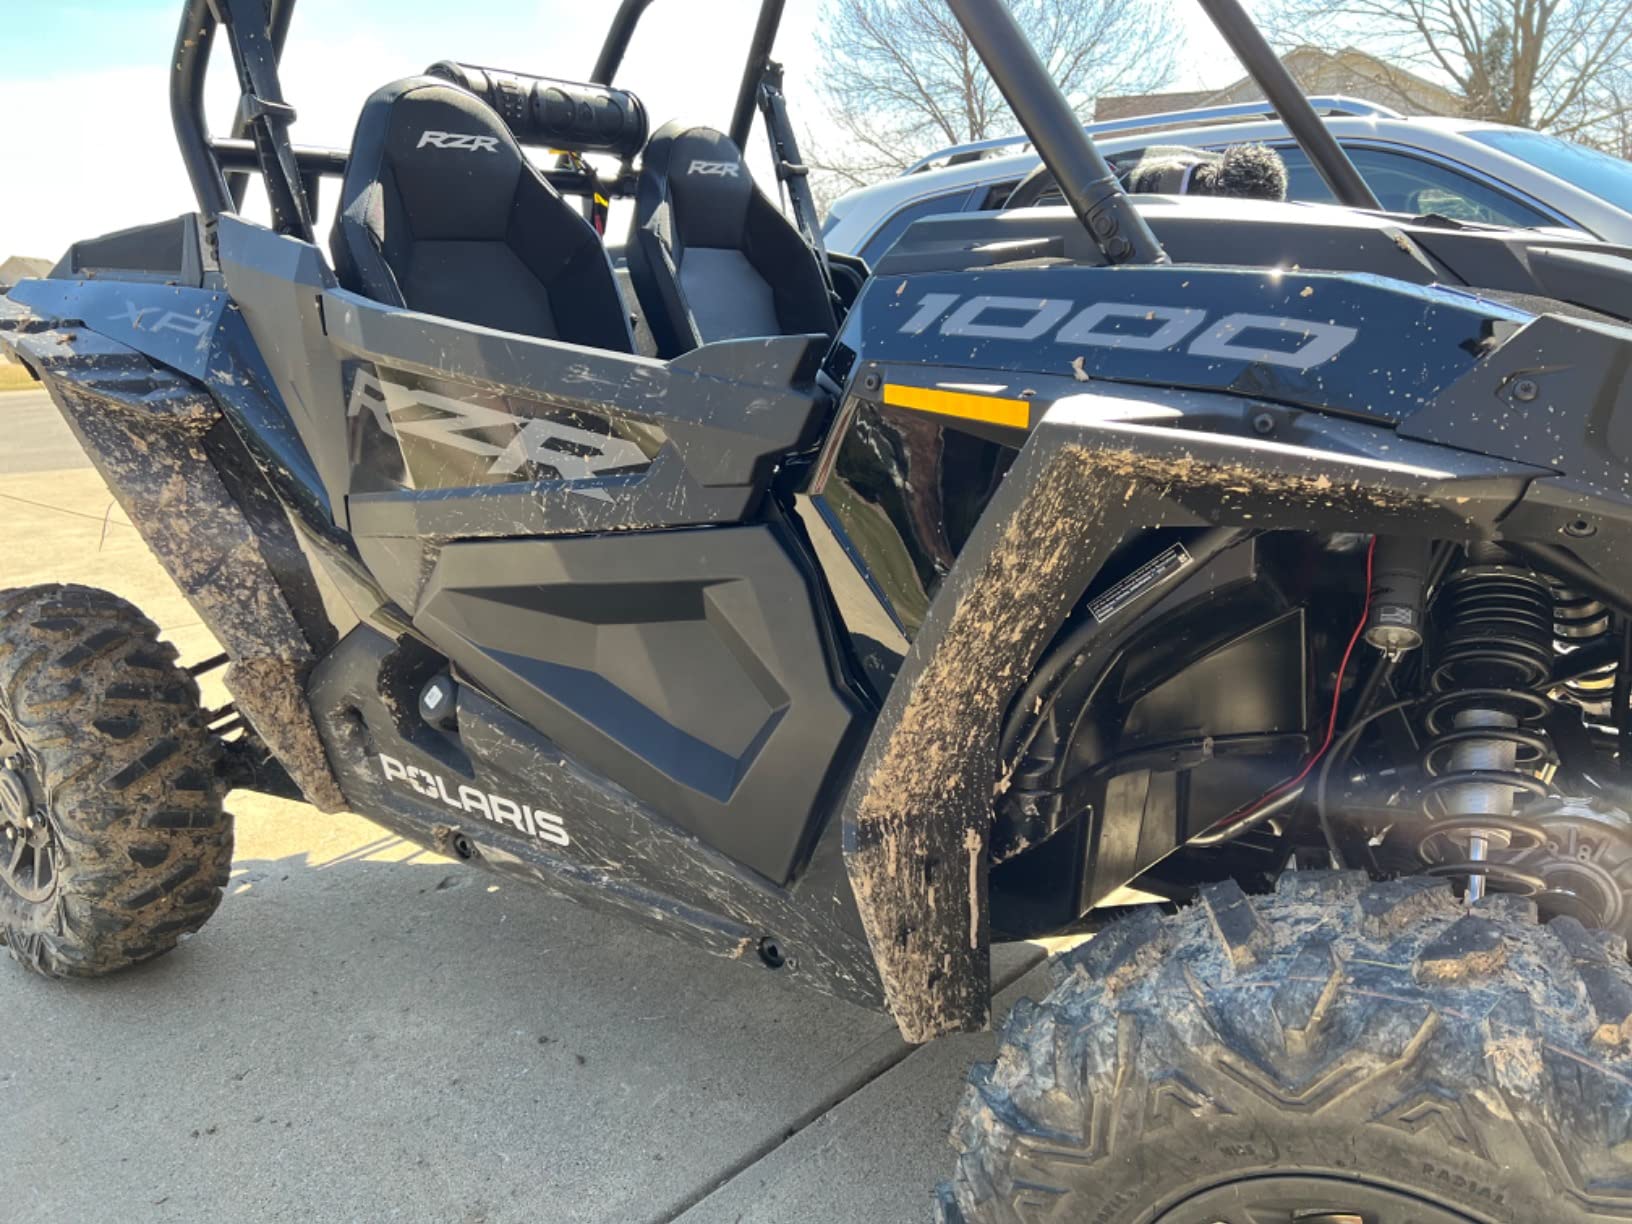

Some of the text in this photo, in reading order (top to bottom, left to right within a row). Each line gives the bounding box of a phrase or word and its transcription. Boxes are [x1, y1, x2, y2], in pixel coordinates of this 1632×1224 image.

[416, 130, 499, 153] RZR
[687, 160, 739, 178] RZR
[898, 293, 1358, 369] 1000
[347, 367, 651, 504] RZR
[378, 752, 570, 847] POLARIS
